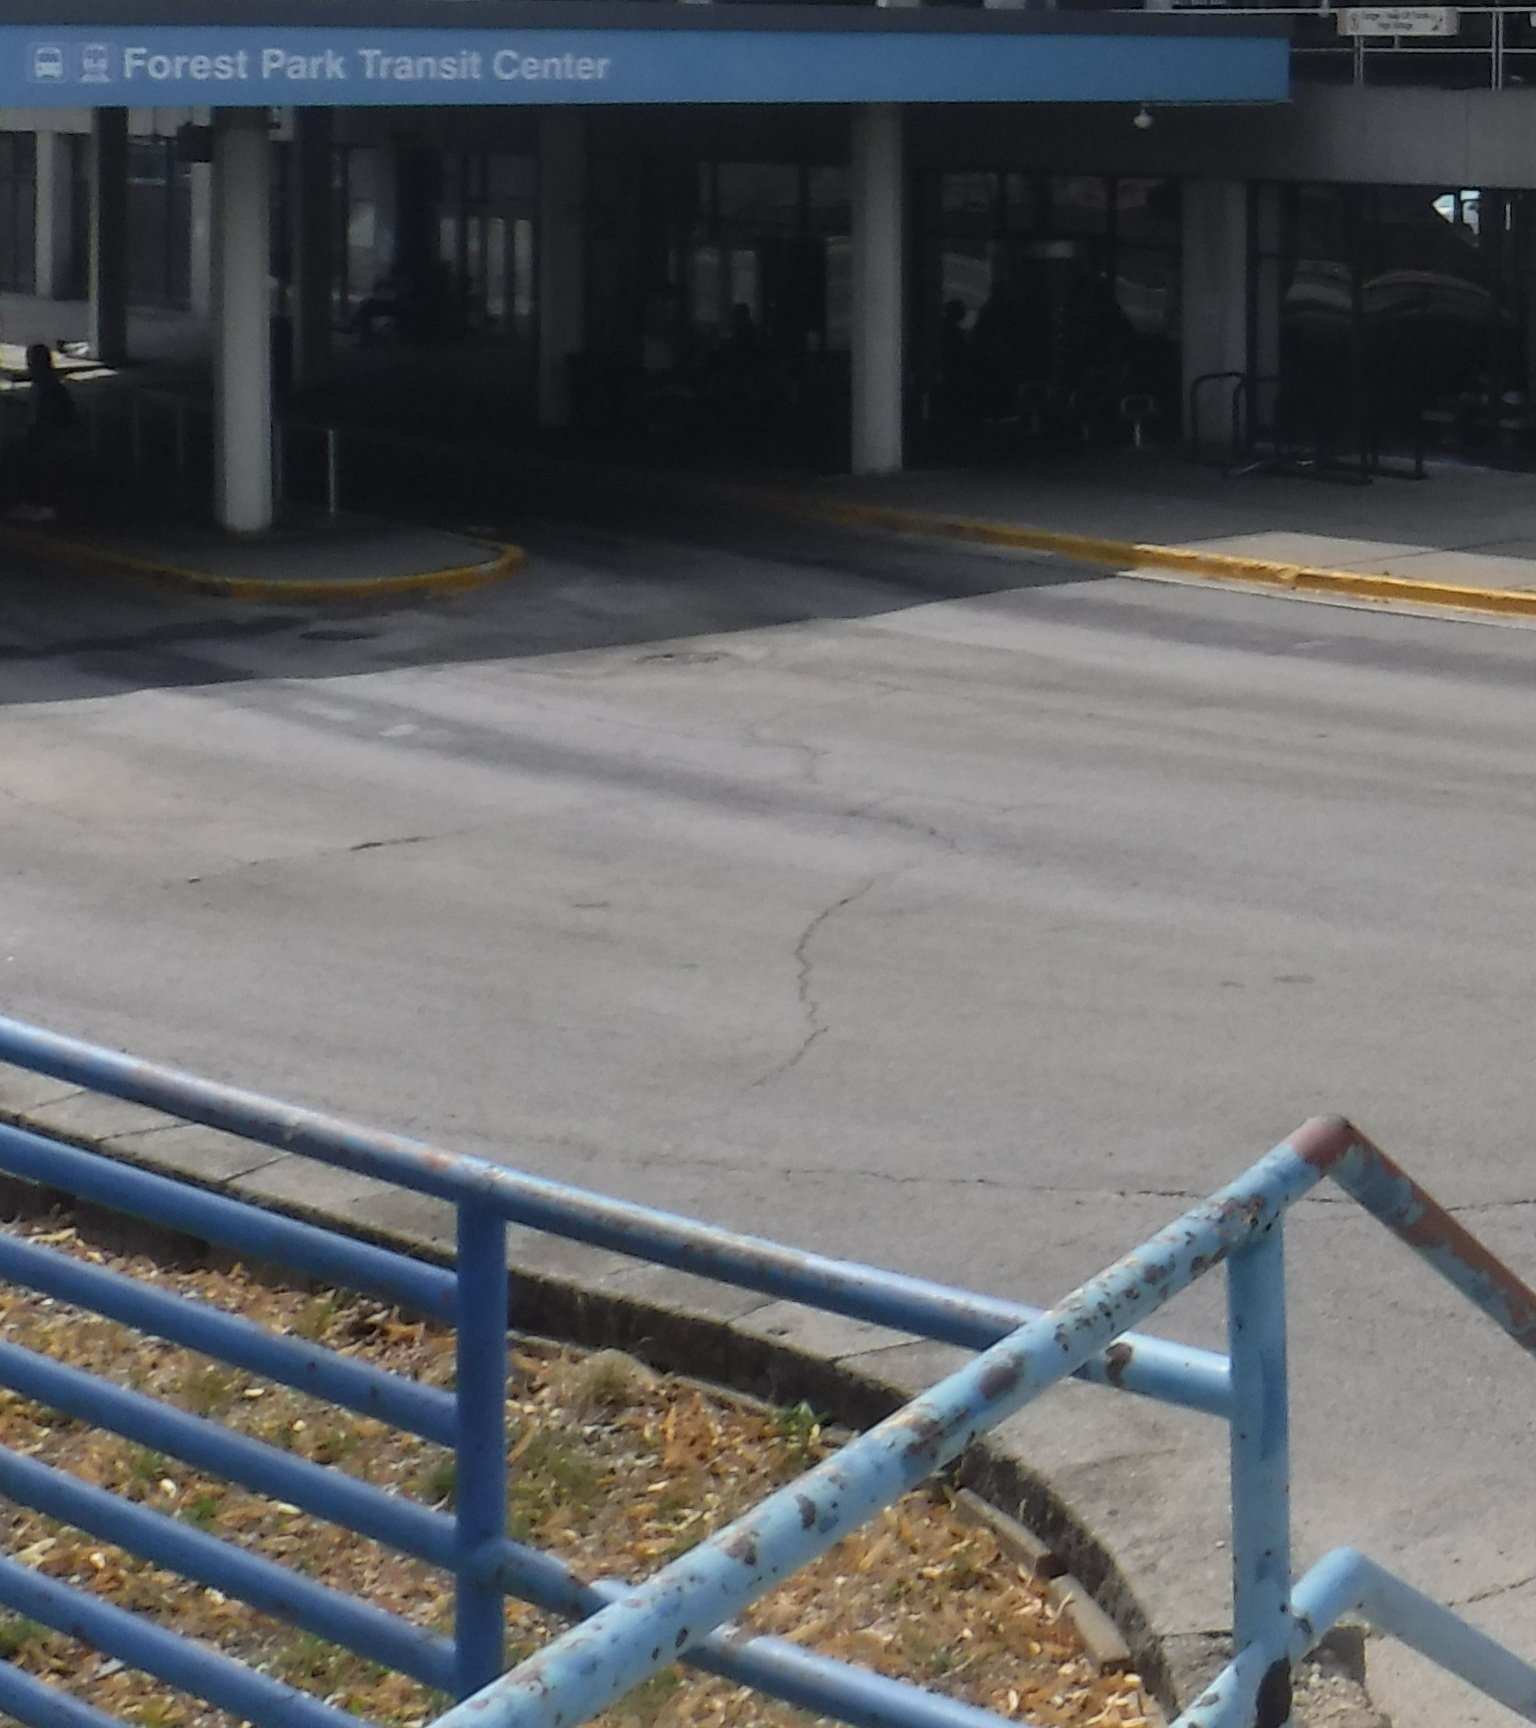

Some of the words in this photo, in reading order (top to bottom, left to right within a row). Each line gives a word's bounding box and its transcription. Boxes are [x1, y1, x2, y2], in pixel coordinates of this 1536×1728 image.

[123, 47, 248, 80] Forest
[262, 48, 346, 80] Park
[358, 49, 483, 80] Transit
[493, 49, 610, 80] Center
